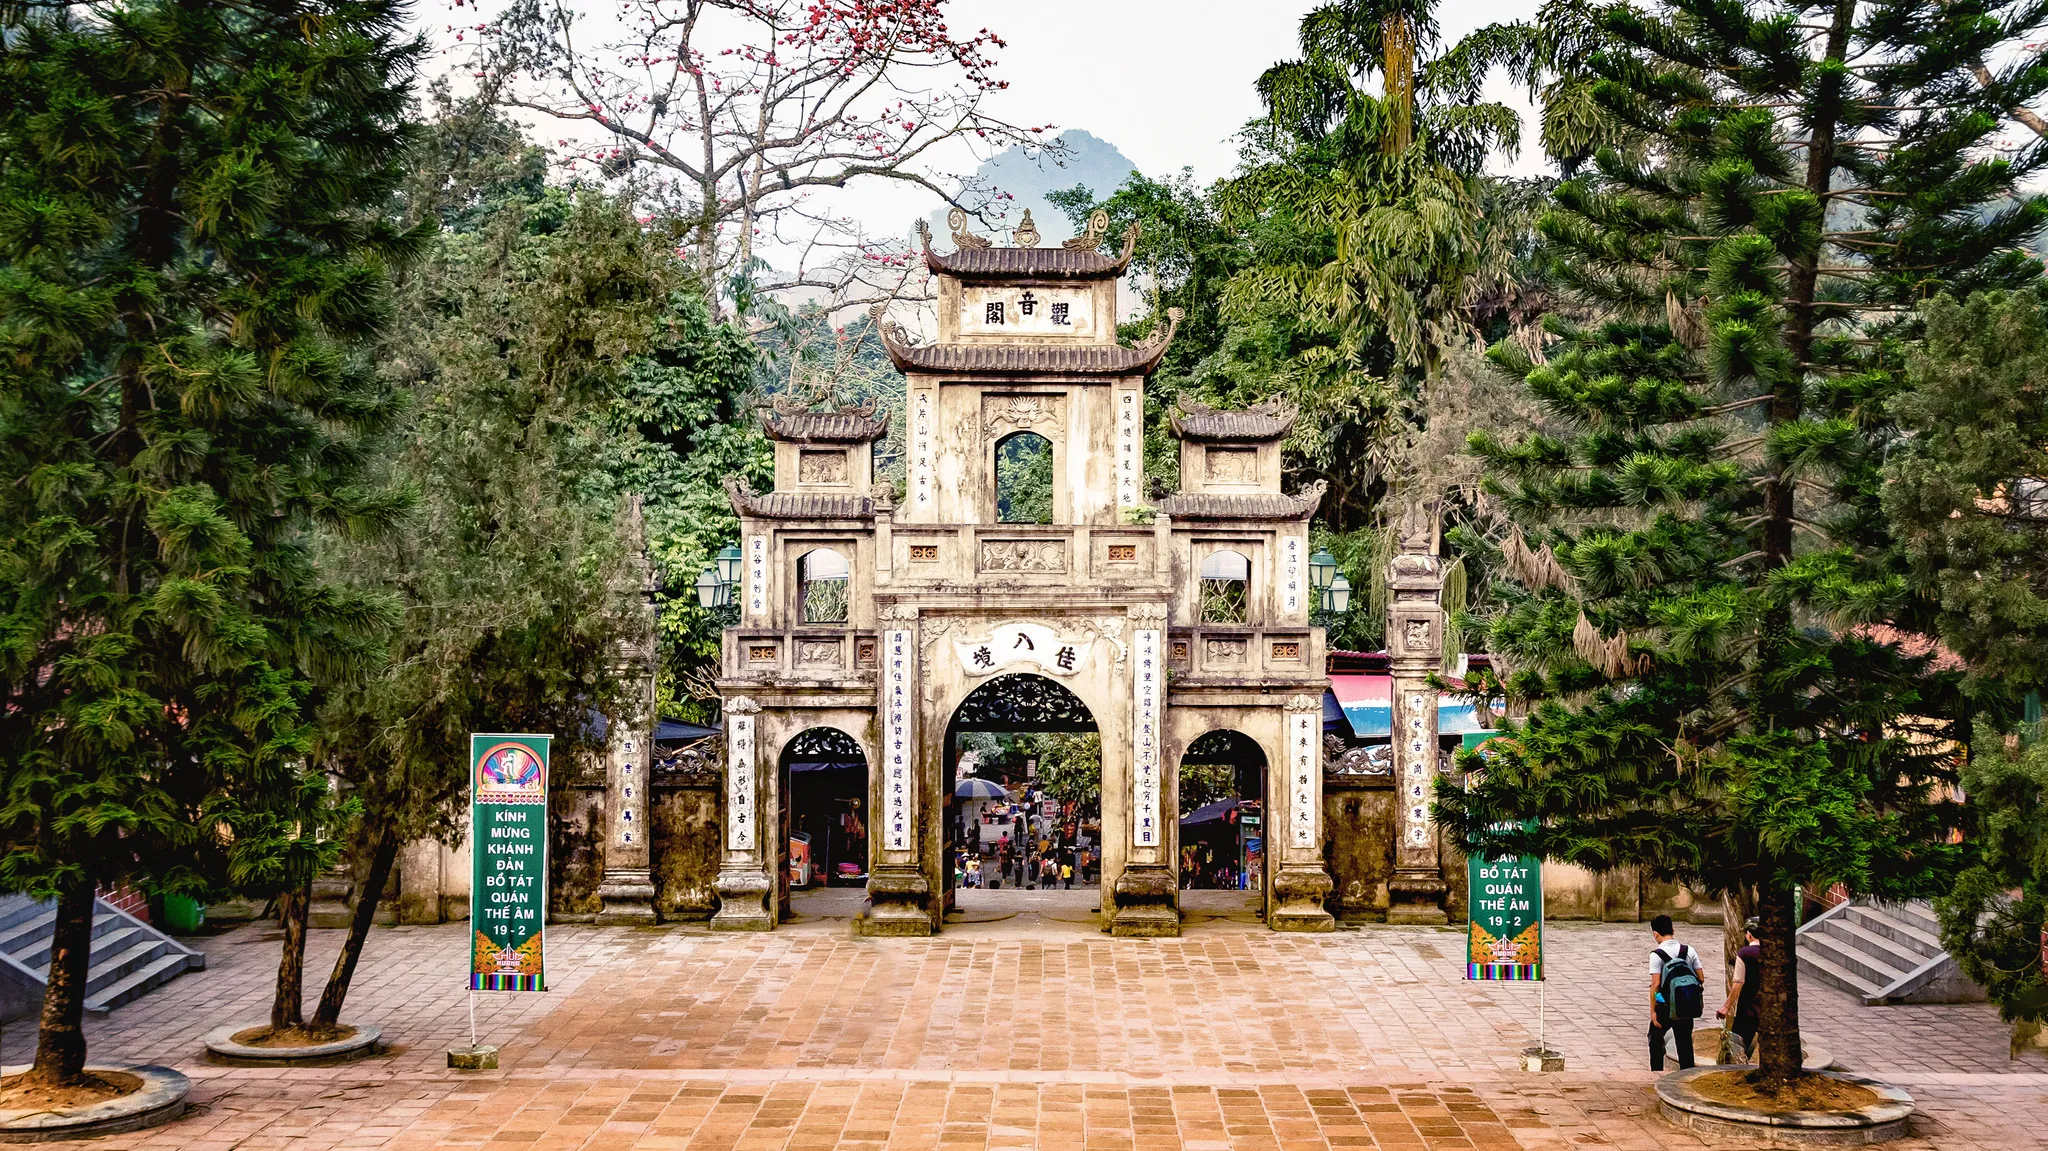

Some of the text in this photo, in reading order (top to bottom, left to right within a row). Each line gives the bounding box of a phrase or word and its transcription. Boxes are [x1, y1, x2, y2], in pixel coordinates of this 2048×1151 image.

[495, 809, 527, 822] KÍNH
[491, 825, 530, 839] MỪNG
[487, 841, 534, 855] KHÁNH
[496, 856, 524, 871] ĐẢN
[1502, 866, 1528, 879] TÁT
[508, 874, 534, 887] TÁT
[1485, 882, 1523, 895] QUÁN
[491, 890, 529, 904] QUÁN
[1478, 896, 1529, 911] THẾ ÂM
[484, 904, 534, 920] THẾ ÂM
[1488, 916, 1503, 926] 19
[1513, 916, 1521, 926] 2
[493, 924, 508, 936] 19
[518, 925, 526, 936] 2
